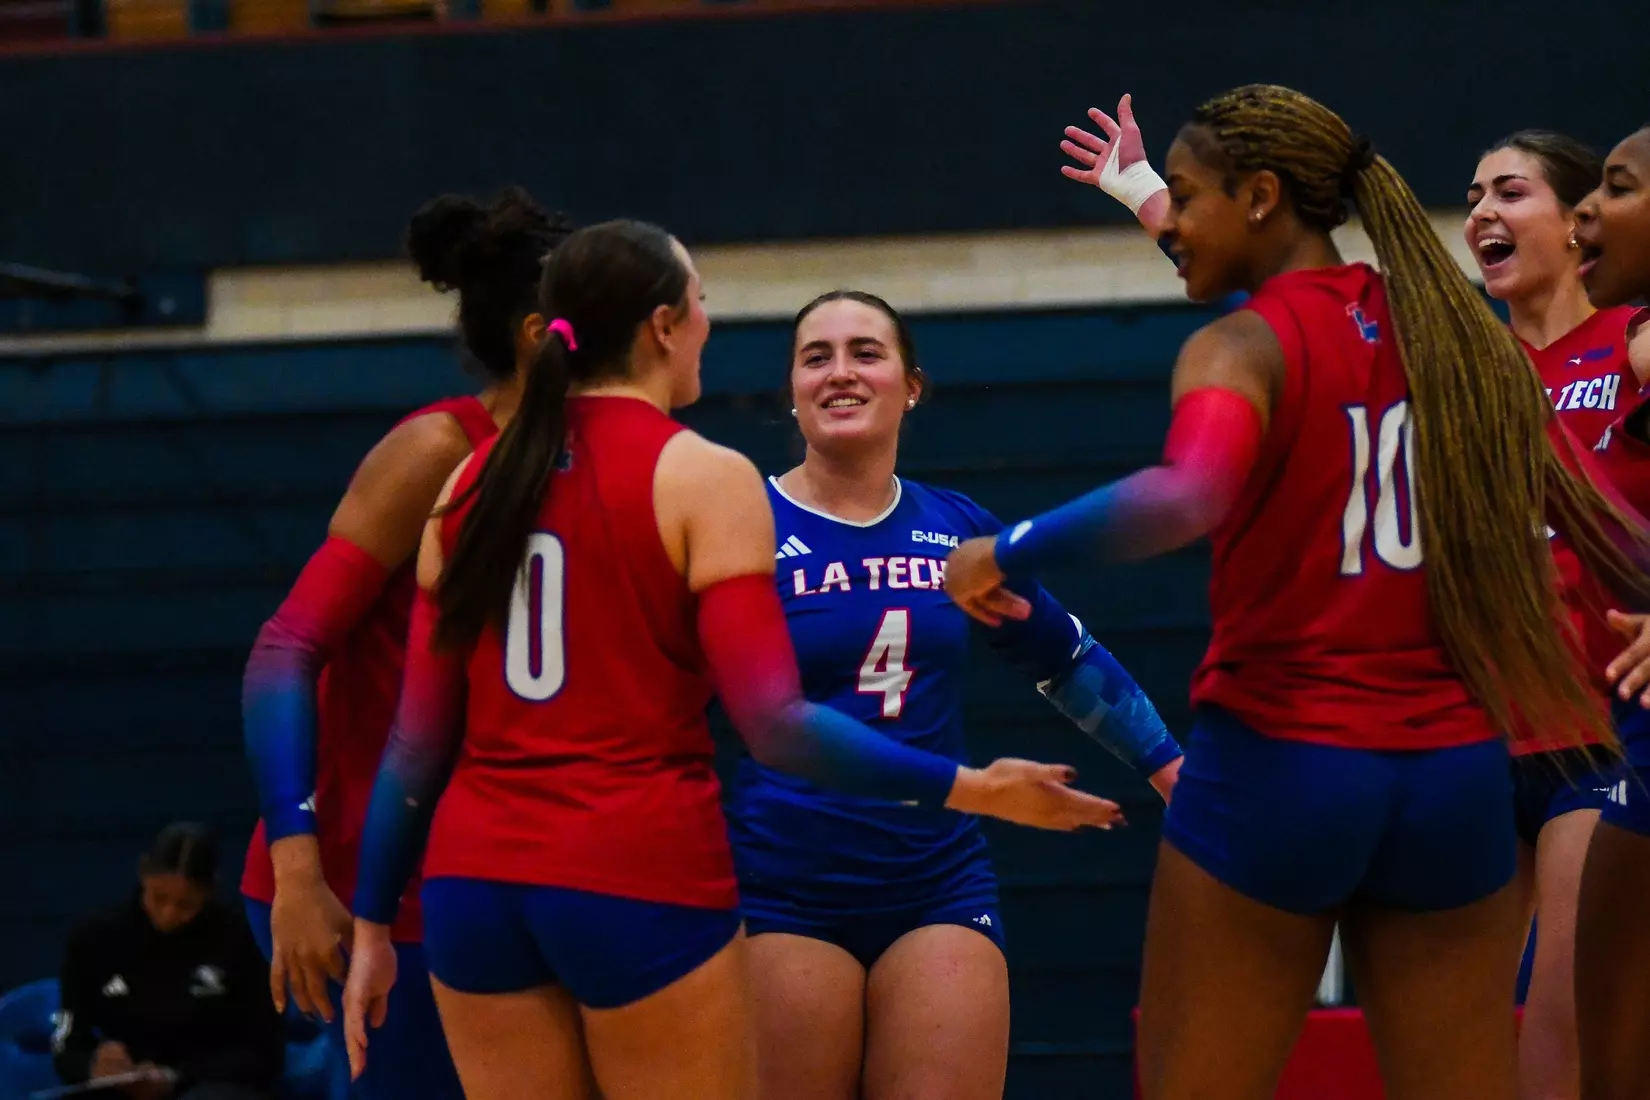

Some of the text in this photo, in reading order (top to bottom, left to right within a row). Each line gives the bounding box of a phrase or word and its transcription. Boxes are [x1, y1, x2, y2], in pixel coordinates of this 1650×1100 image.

[1555, 374, 1621, 411] TECH
[1340, 401, 1424, 575] 10
[505, 532, 566, 701] 0
[793, 556, 948, 596] LA TECH
[857, 609, 914, 718] 4
